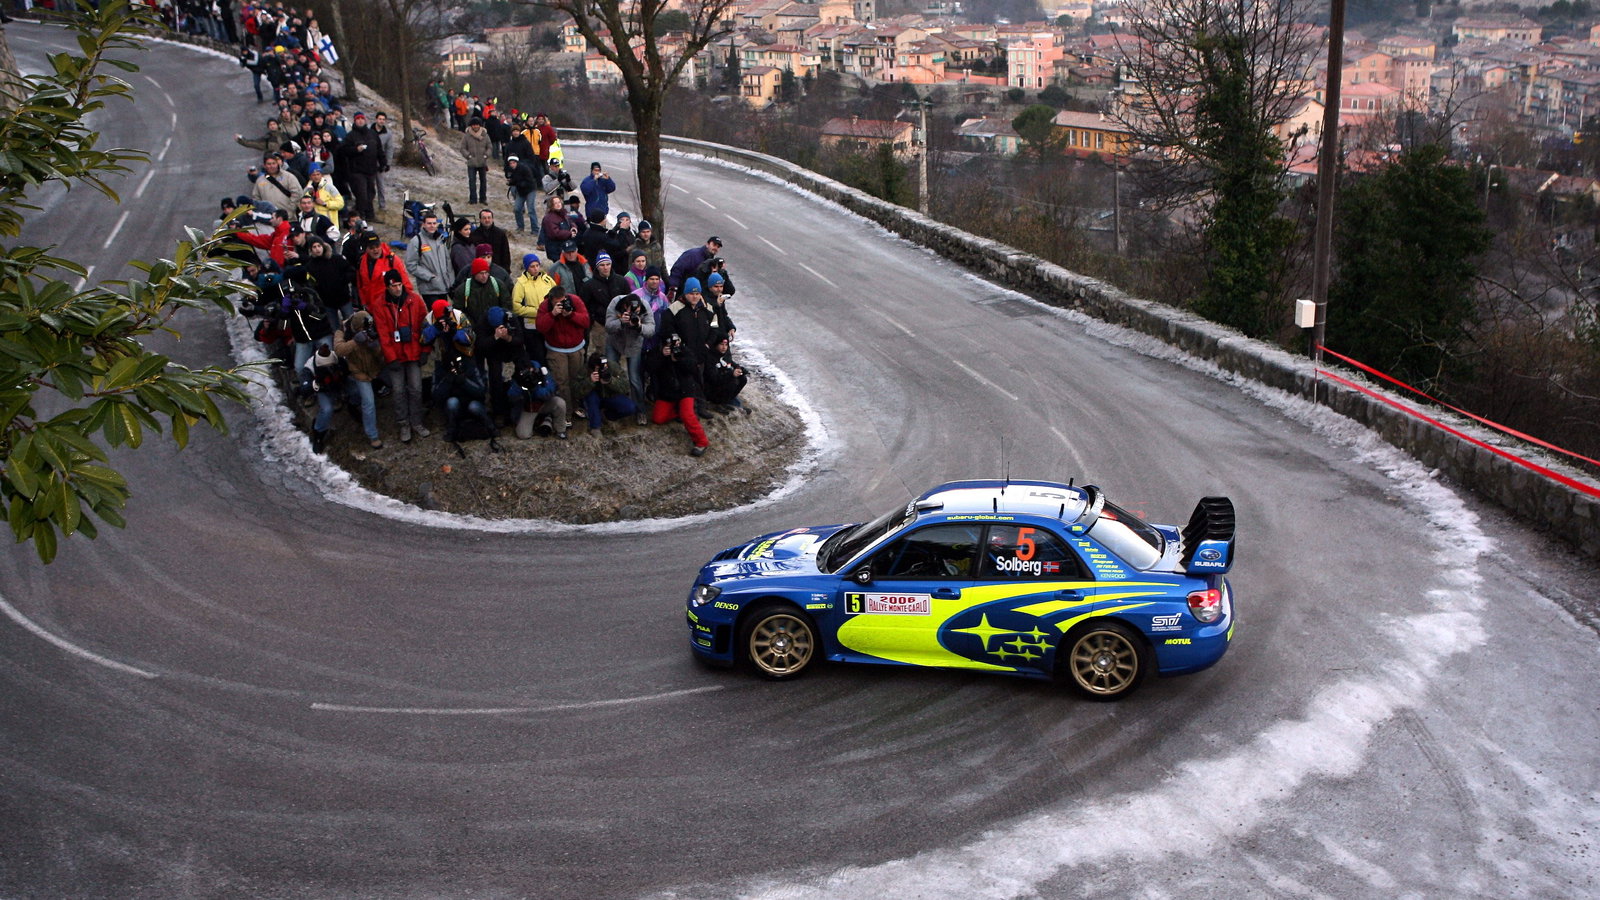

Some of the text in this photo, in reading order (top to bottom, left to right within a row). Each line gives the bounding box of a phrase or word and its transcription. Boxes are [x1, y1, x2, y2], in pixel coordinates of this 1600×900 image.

[1029, 491, 1066, 500] 5
[946, 514, 1014, 522] subaru-global.com
[1015, 527, 1036, 561] 5
[996, 555, 1042, 576] Solberg
[714, 601, 739, 611] DENSO
[851, 594, 861, 613] 5
[868, 598, 888, 612] RALLYE
[880, 596, 916, 605] 2006
